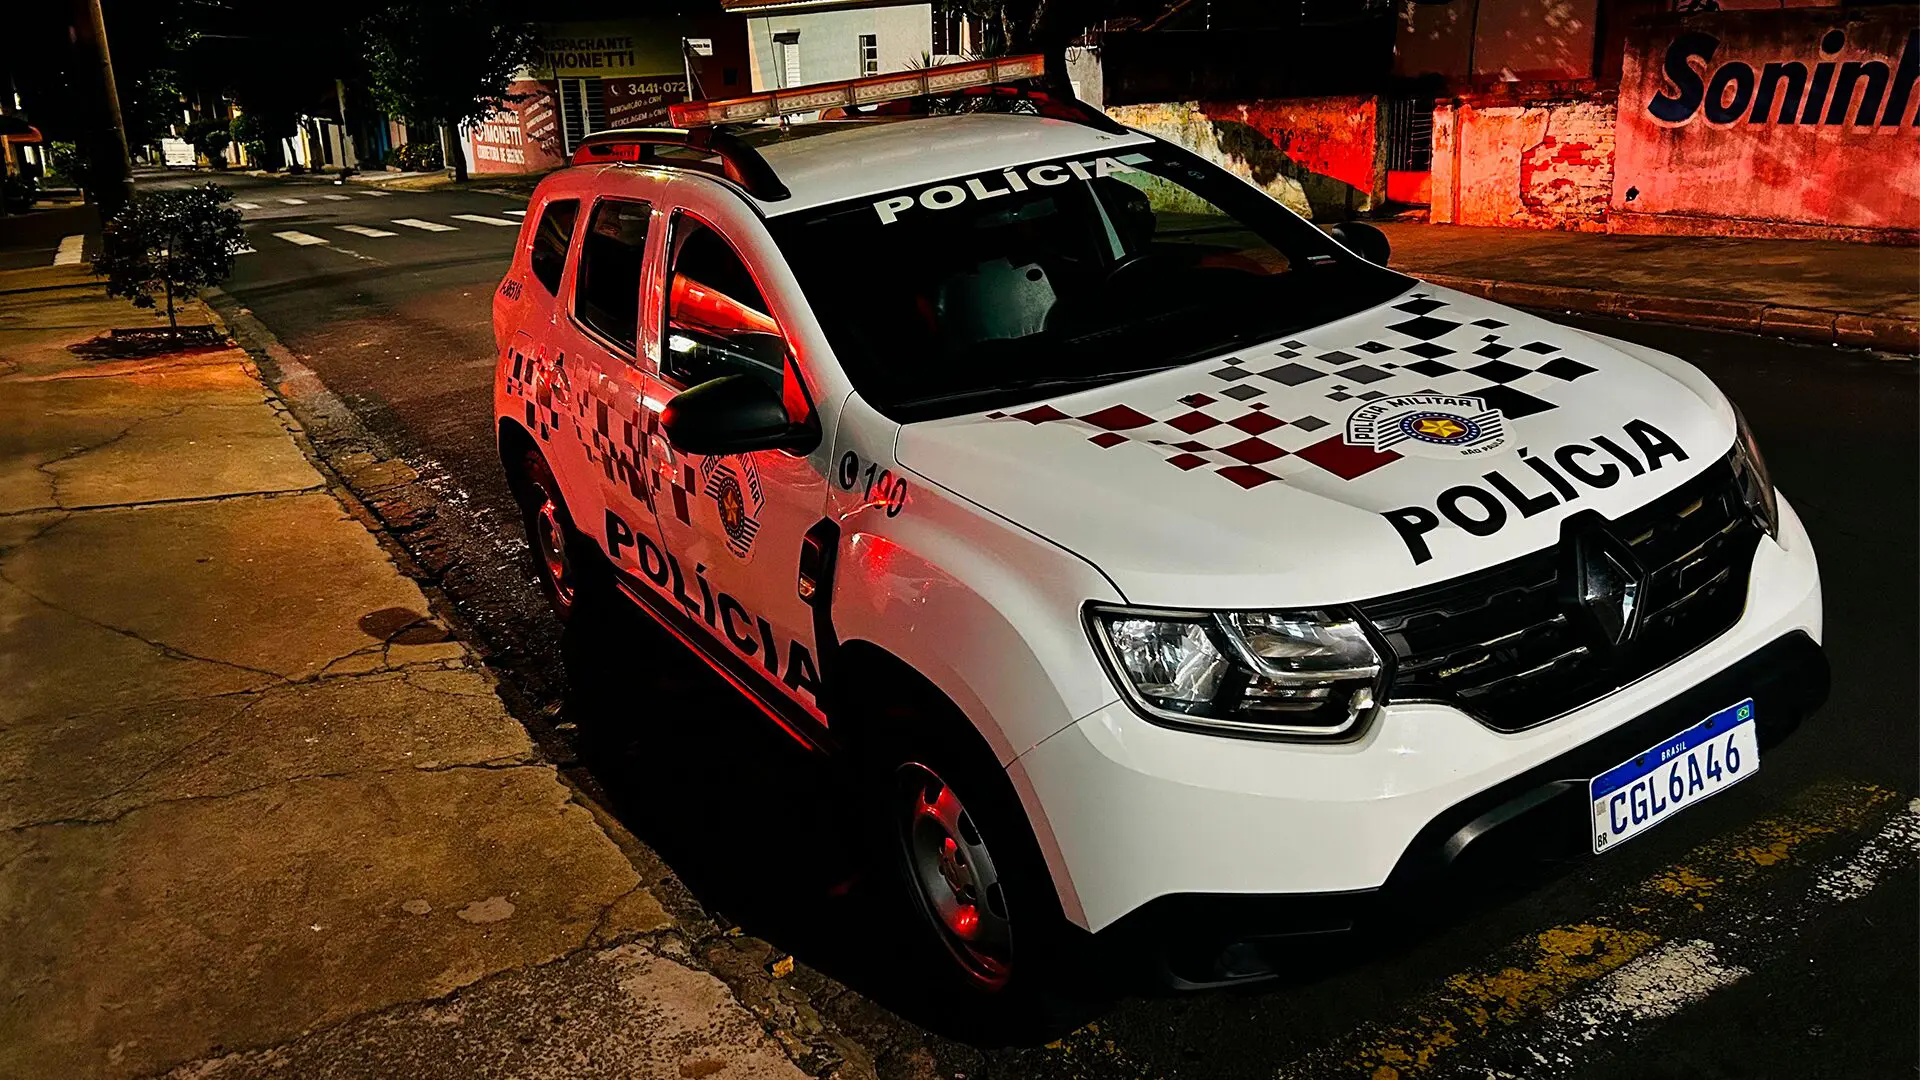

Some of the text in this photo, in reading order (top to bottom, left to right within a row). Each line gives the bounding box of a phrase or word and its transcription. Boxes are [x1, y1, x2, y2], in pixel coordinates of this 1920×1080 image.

[544, 50, 635, 68] IMONETTI
[872, 155, 1137, 226] POLÍCIA
[1354, 396, 1473, 440] POLÍCIA MILITAR
[863, 462, 907, 518] 190
[1380, 418, 1690, 566] POLÍCIA
[604, 507, 833, 714] POLÍCIA
[1660, 741, 1687, 762] BRASIL
[1609, 733, 1741, 836] CGL6A46
[1597, 831, 1608, 848] BR
